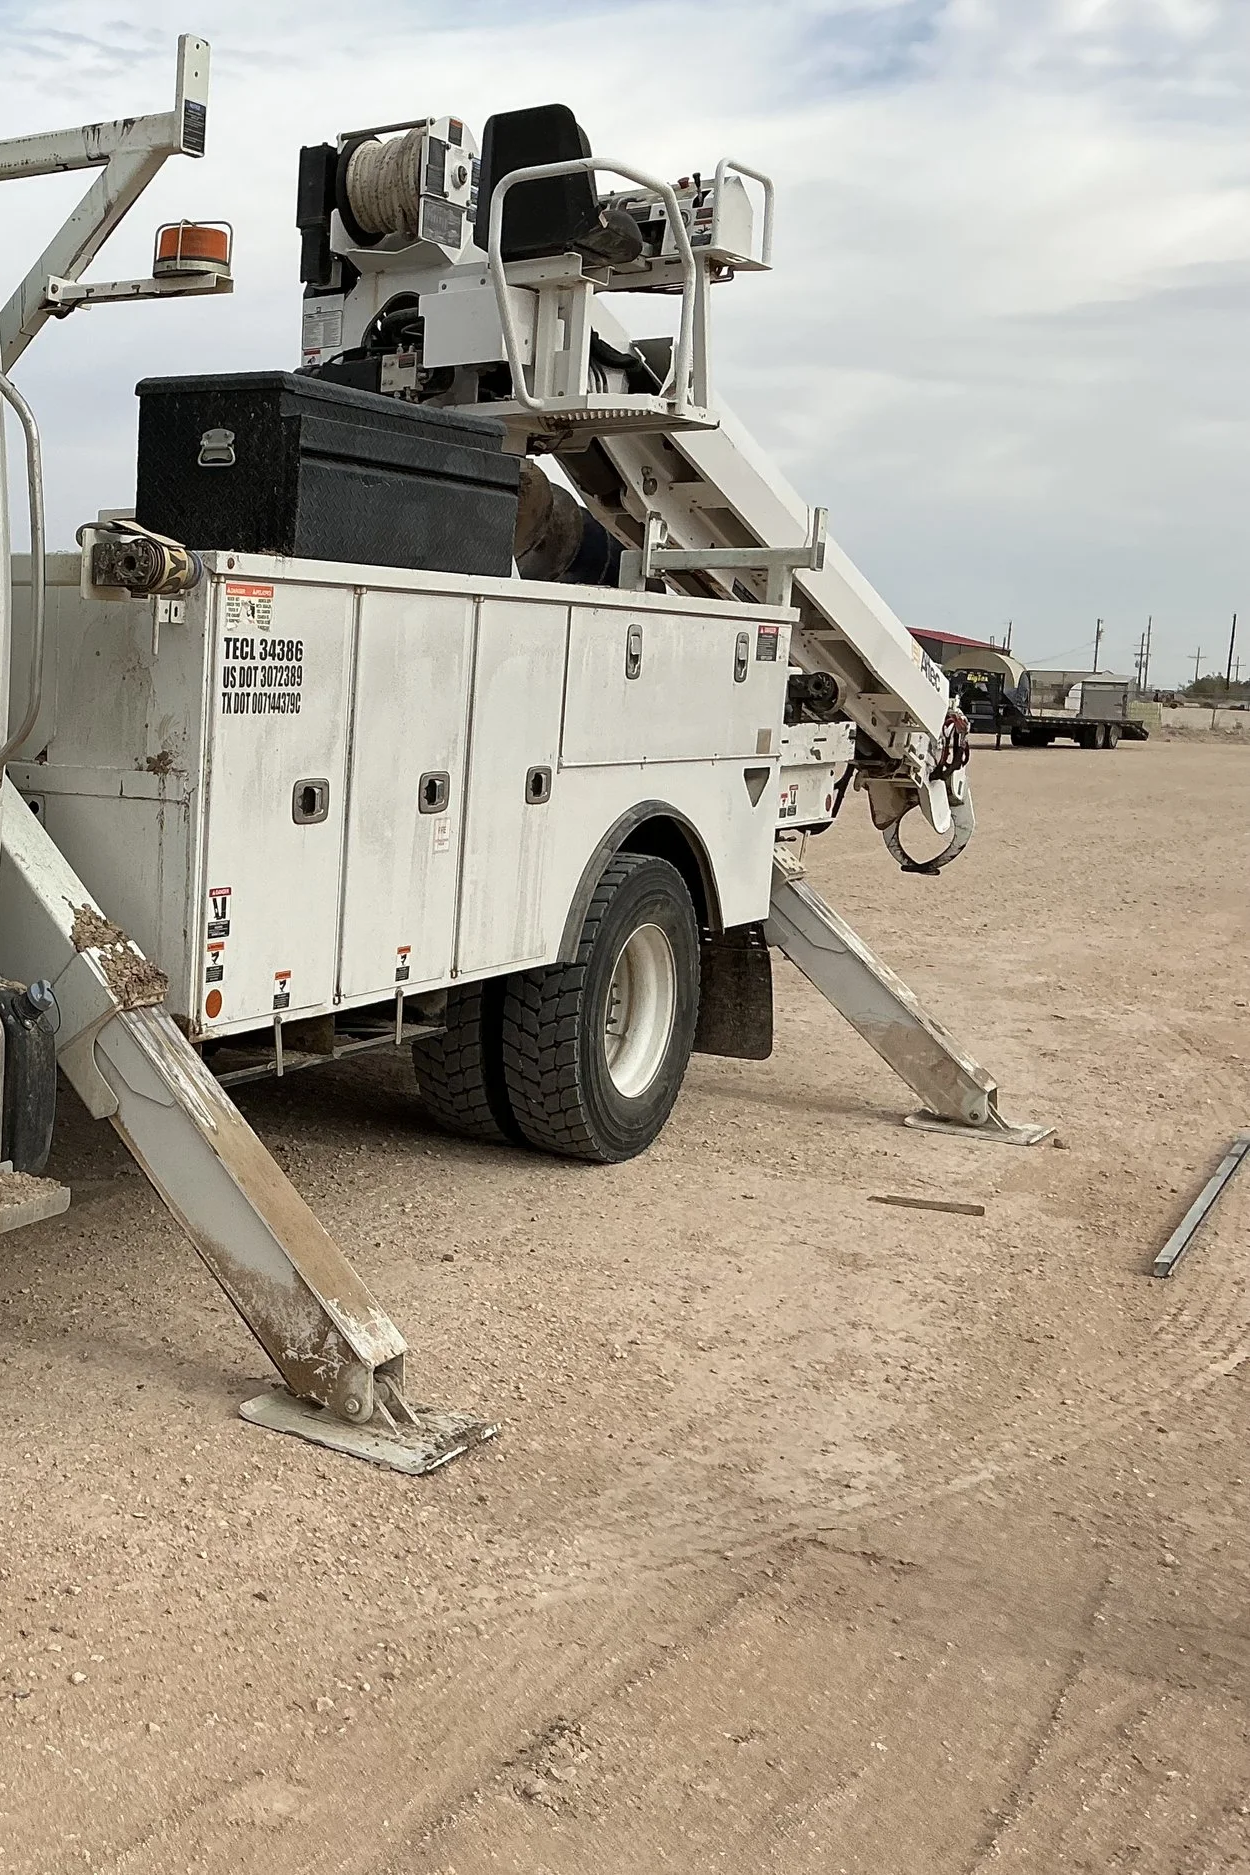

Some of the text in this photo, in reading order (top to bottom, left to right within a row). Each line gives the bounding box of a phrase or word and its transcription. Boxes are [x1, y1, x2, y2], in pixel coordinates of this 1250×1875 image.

[223, 637, 304, 662] TECL 34386
[222, 665, 303, 689] US DOT 3072389
[221, 692, 302, 715] TX DOT 007144379C
